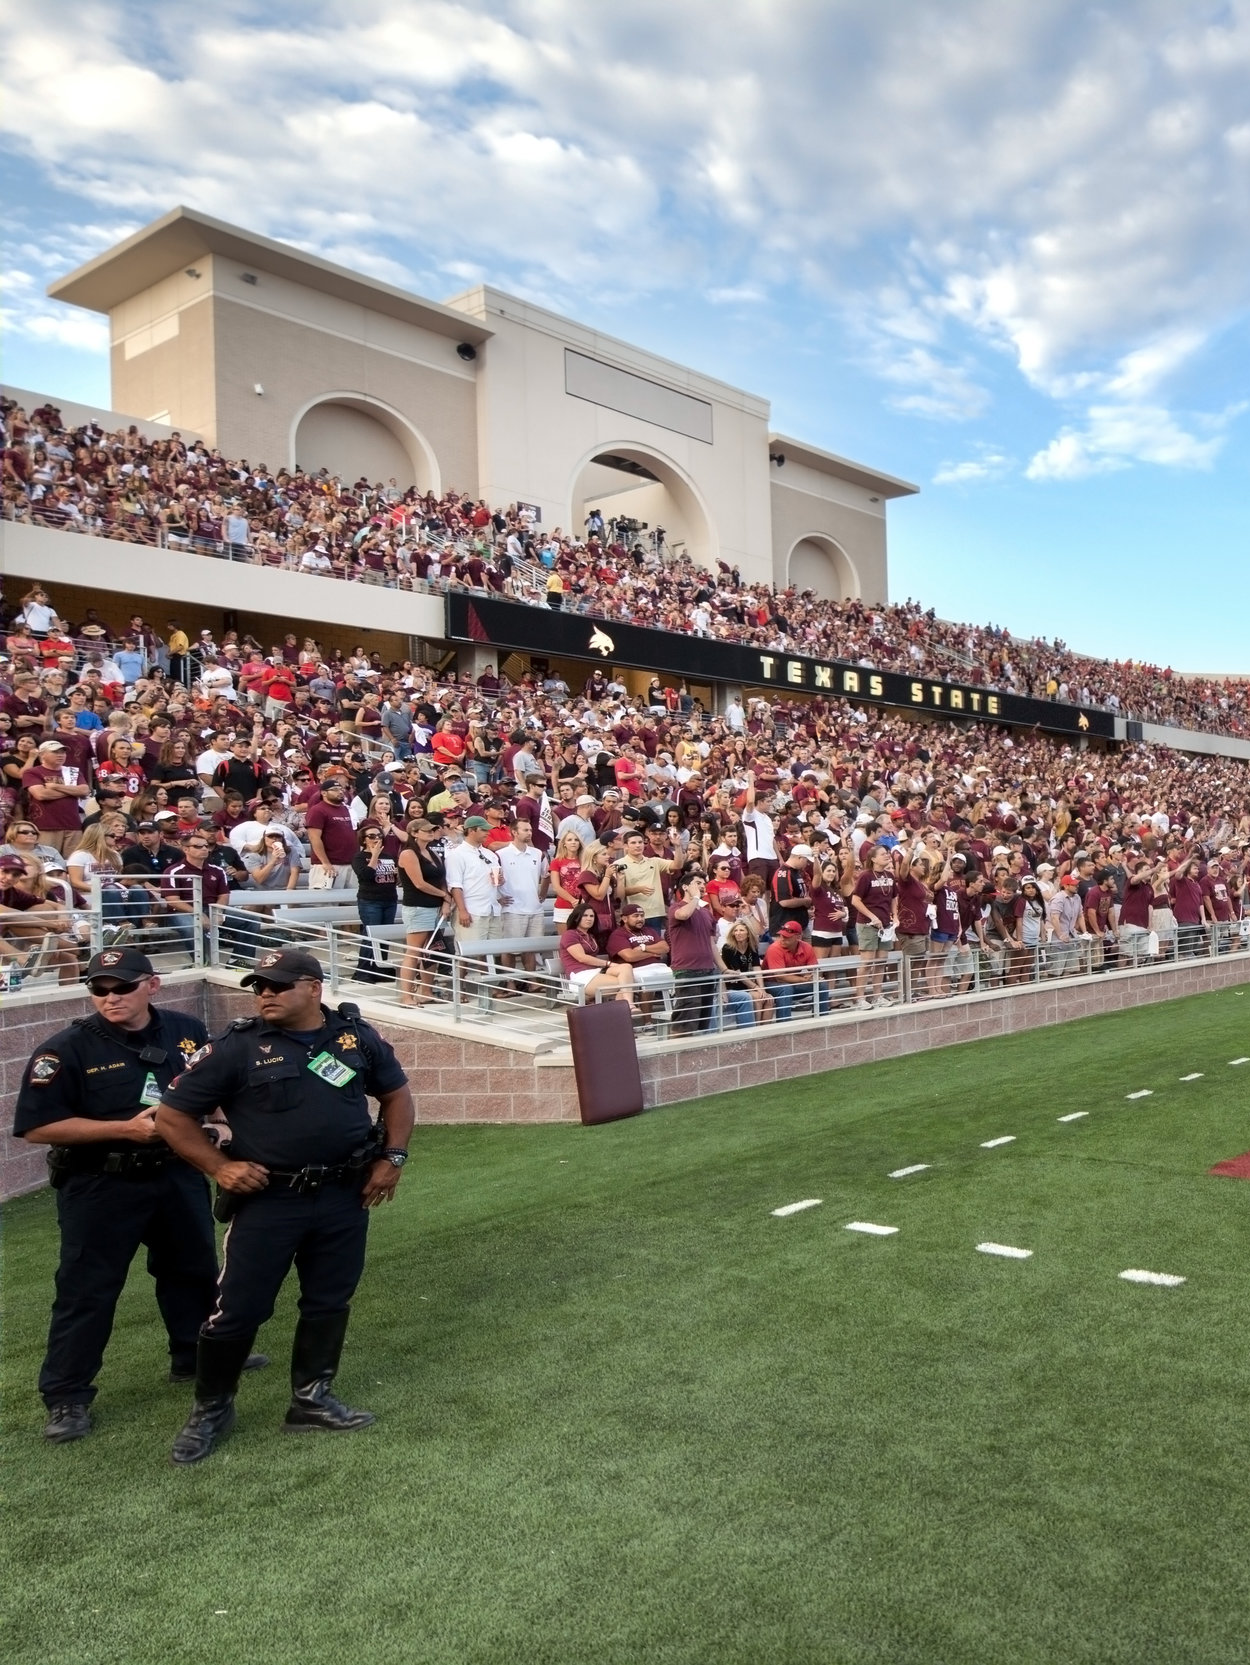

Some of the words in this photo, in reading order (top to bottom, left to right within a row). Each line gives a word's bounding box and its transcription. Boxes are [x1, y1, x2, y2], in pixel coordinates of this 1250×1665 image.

[760, 655, 884, 696] TEXAS
[911, 682, 1002, 715] STATE
[263, 1056, 284, 1065] LUCIO
